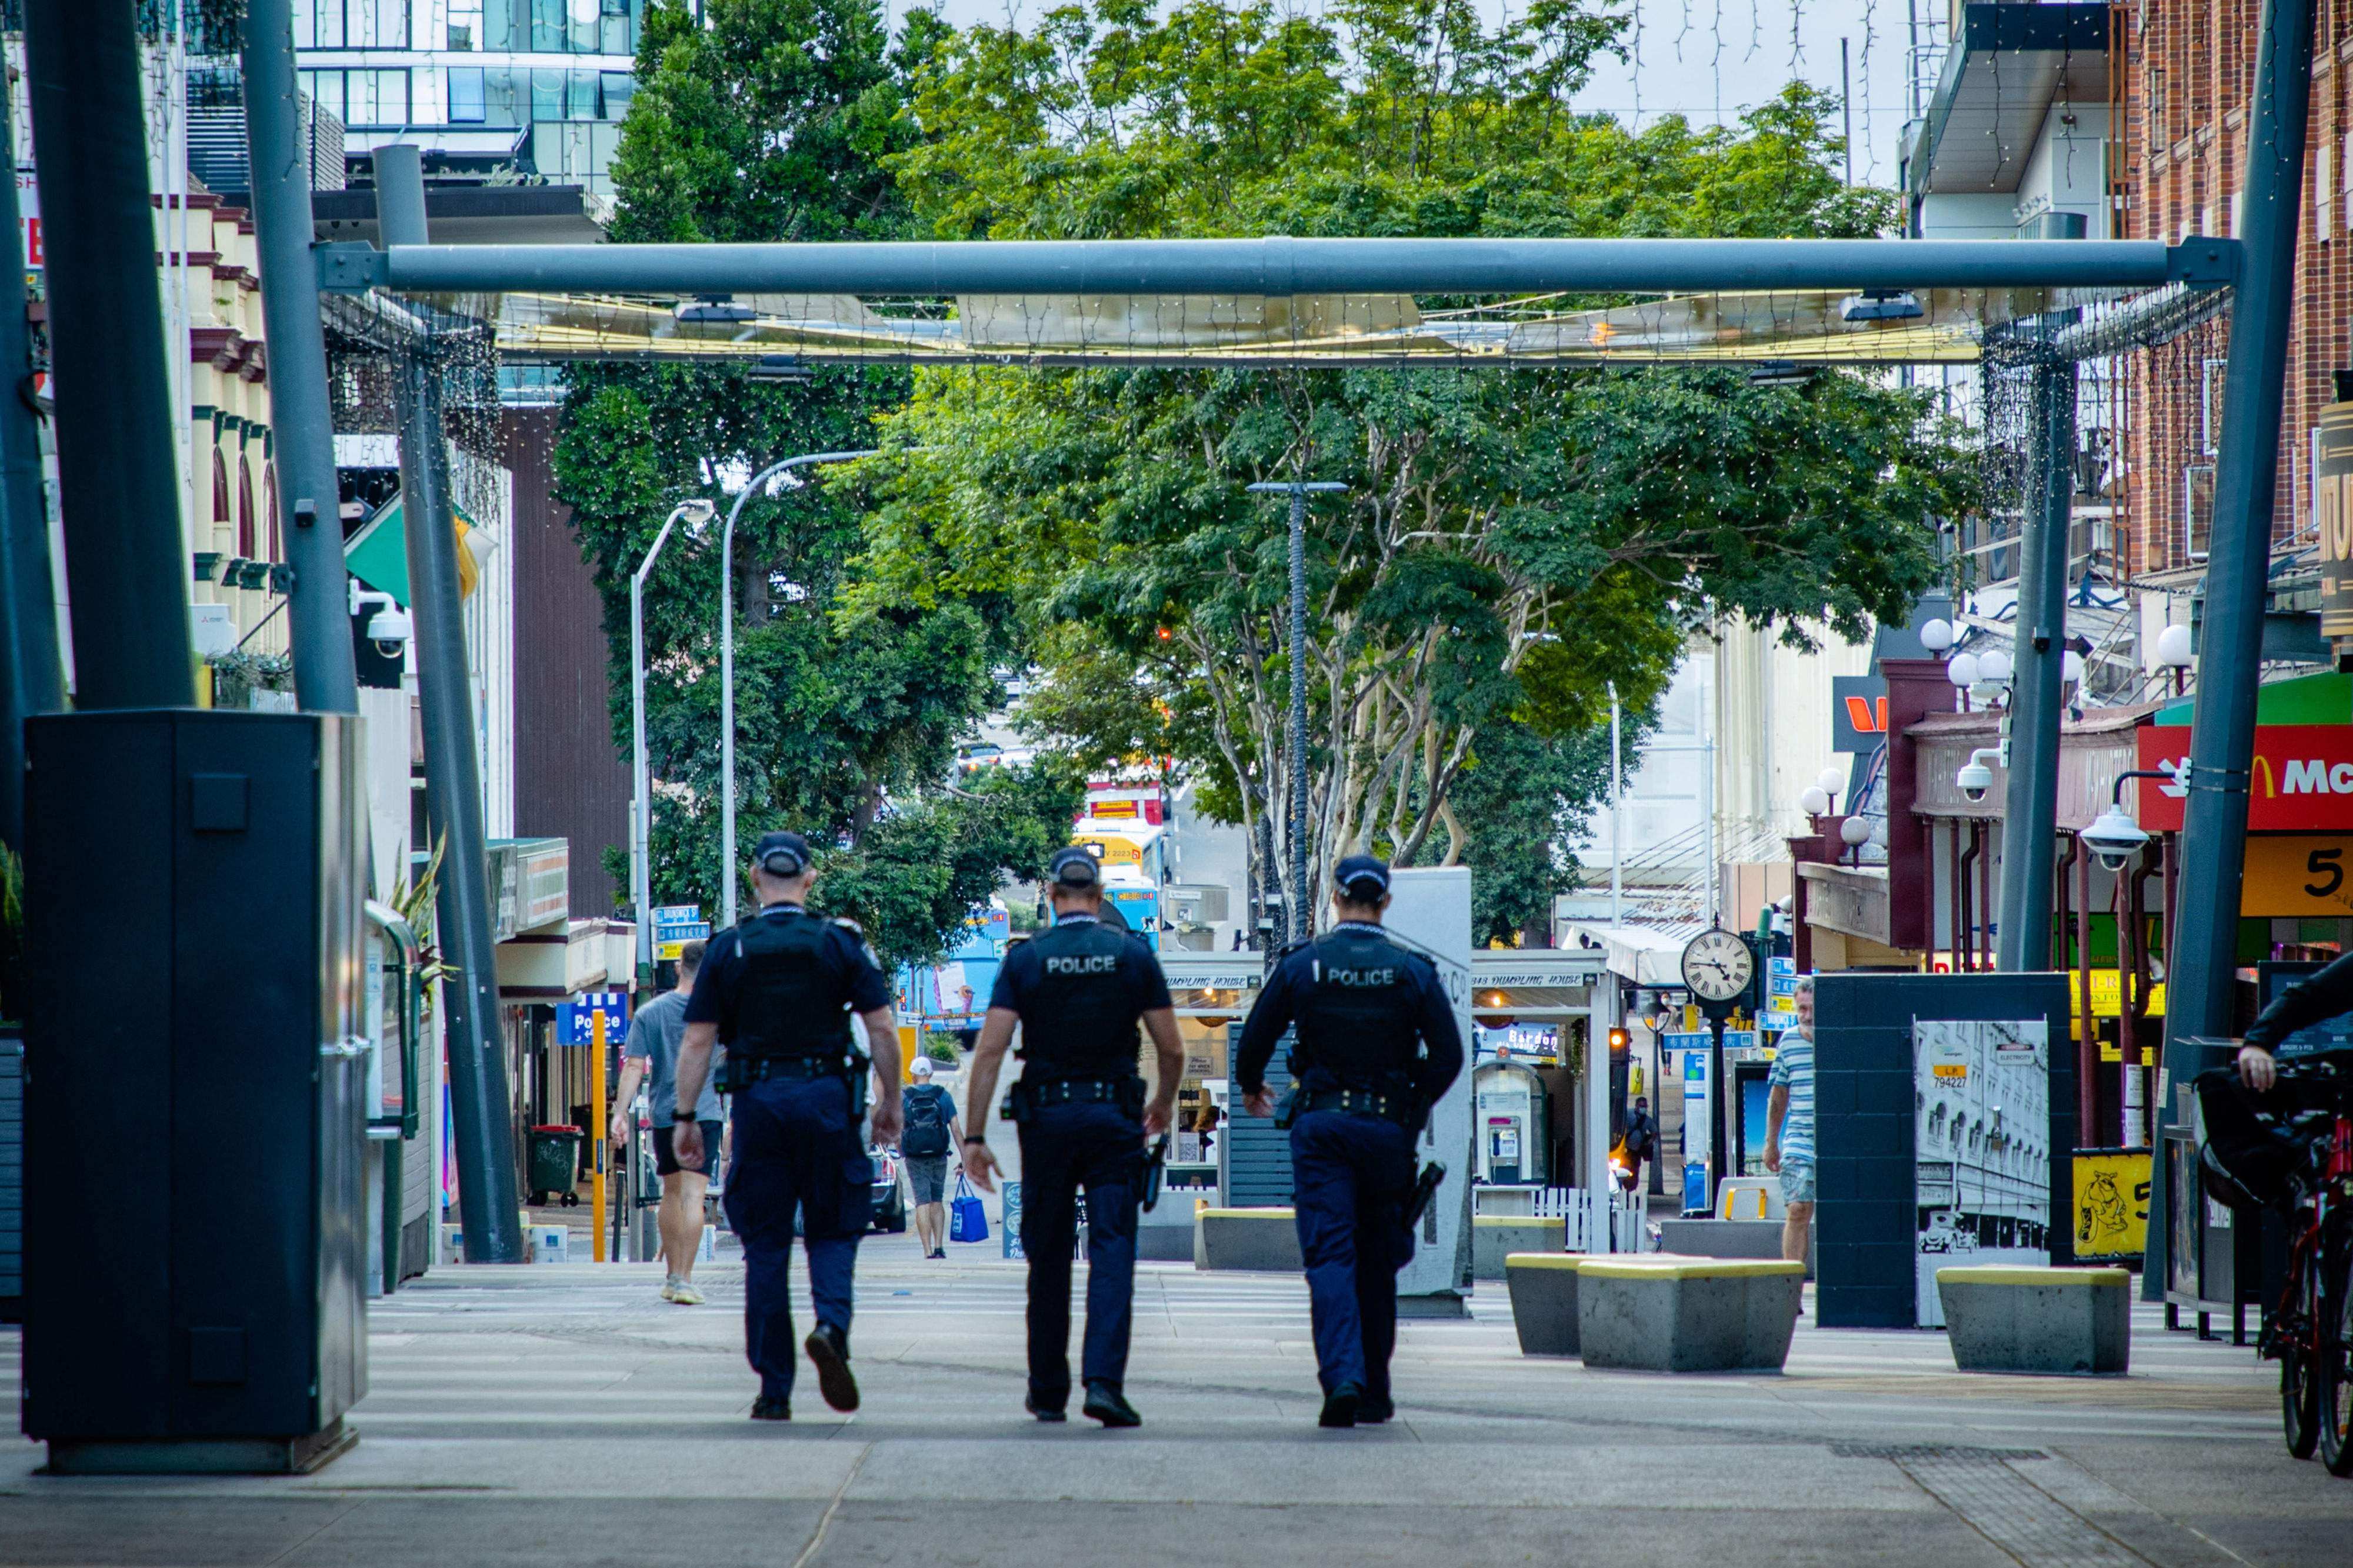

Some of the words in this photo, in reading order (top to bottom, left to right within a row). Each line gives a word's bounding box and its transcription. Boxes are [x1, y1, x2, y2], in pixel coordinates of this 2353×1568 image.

[2304, 848, 2344, 898] 5
[1047, 955, 1115, 973] POLICE
[1166, 977, 1211, 986] UMPLING
[1214, 977, 1246, 986] HOUSE
[1328, 968, 1394, 986] POLICE
[1491, 975, 1544, 986] DUMPLING
[1548, 975, 1581, 985] HOUSE
[575, 1014, 620, 1029] Poce
[1509, 1029, 1558, 1045] Bardon
[1934, 1077, 1967, 1088] 794227
